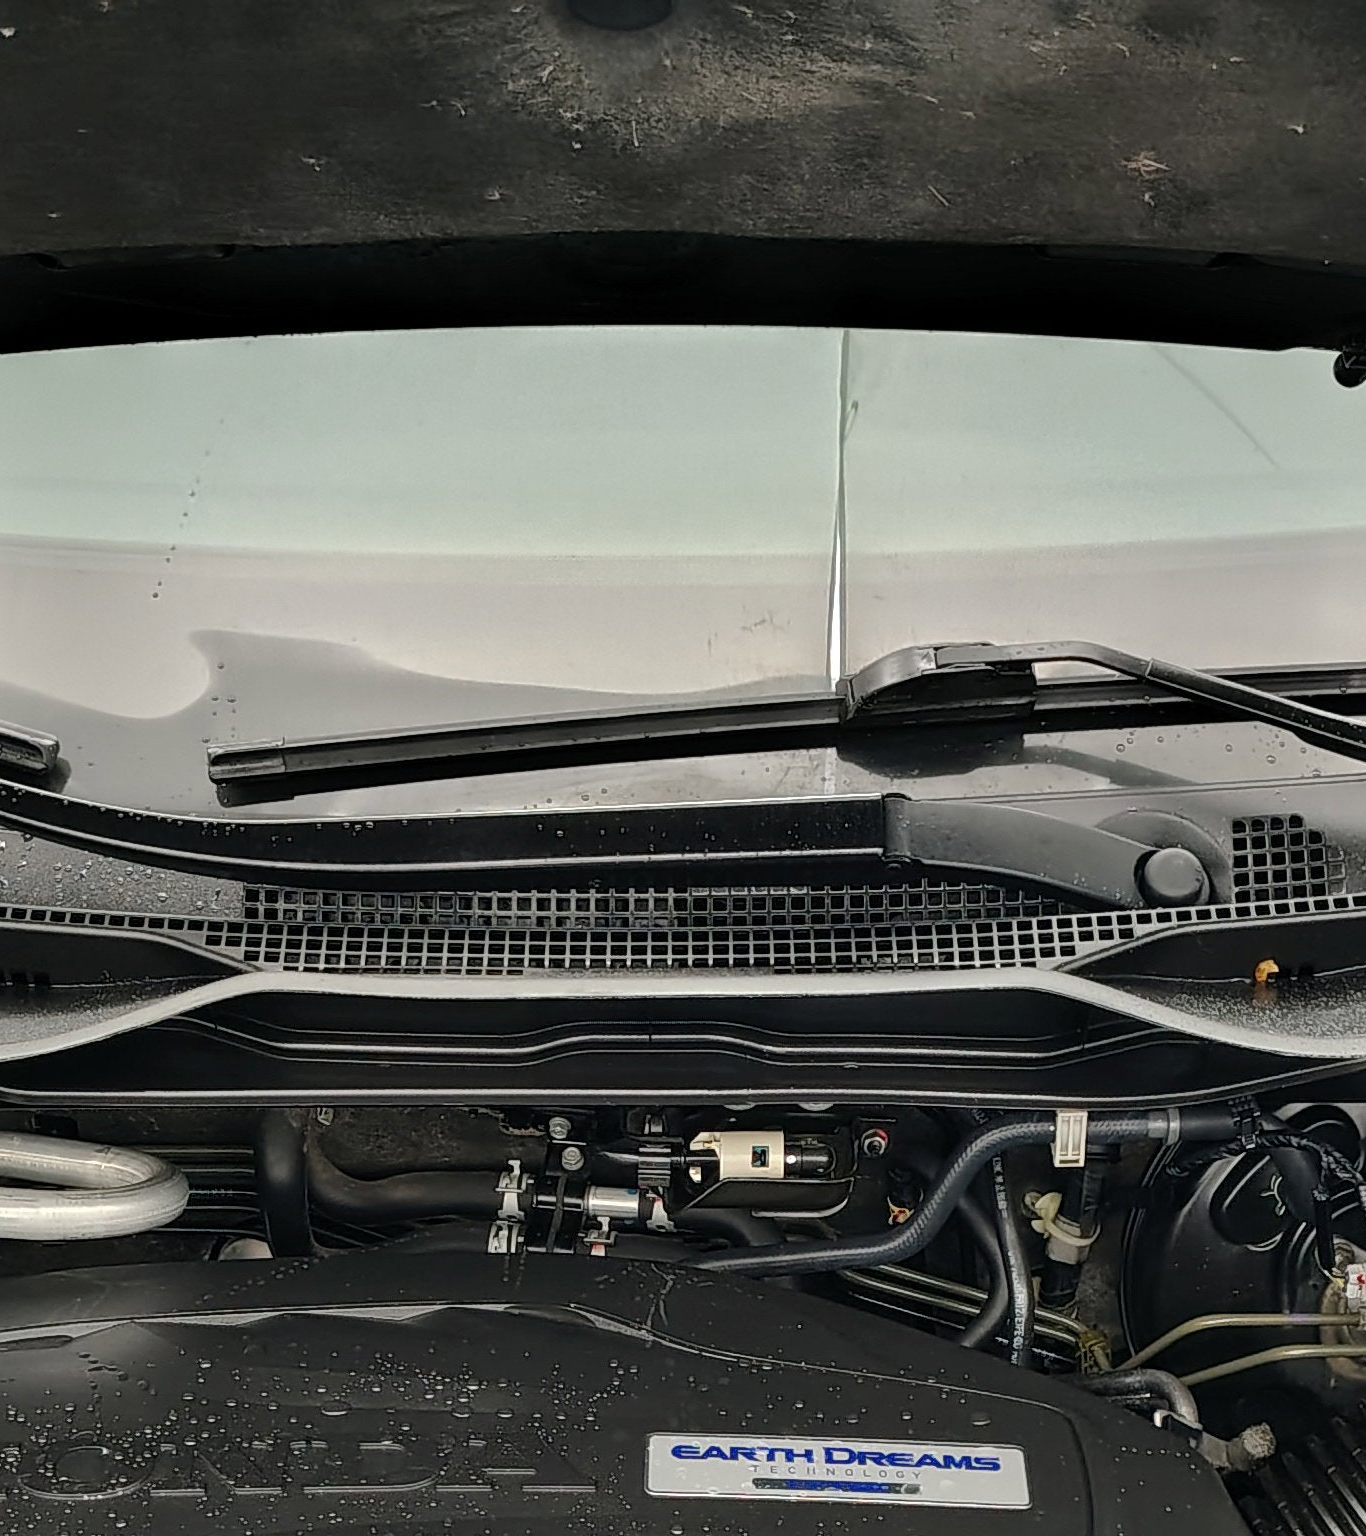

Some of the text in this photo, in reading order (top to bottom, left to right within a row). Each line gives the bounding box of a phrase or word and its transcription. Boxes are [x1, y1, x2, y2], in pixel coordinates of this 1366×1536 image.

[670, 1444, 1001, 1472] EARTH DREAMS
[750, 1465, 922, 1479] TECHNOLOGY
